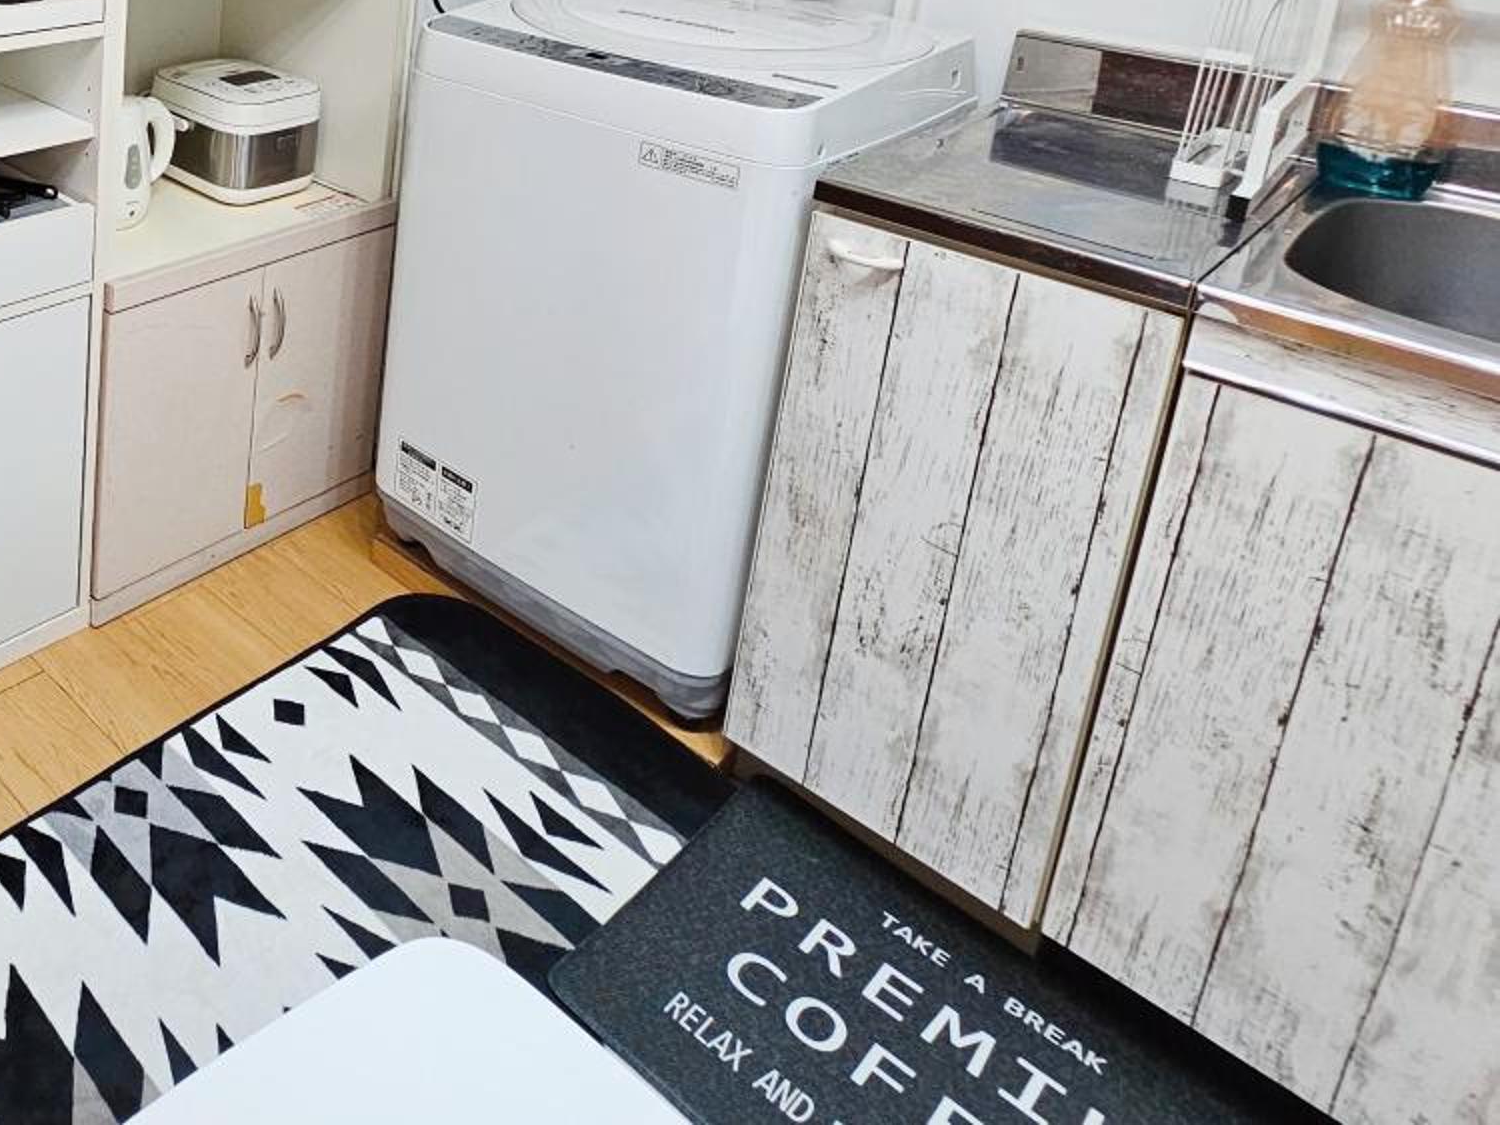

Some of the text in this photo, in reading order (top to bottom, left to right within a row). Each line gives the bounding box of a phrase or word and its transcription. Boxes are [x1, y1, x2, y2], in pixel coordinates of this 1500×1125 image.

[663, 991, 815, 1124] RELAX AND
[739, 876, 1106, 1125] PREMI
[882, 911, 1108, 1074] TAKE A BREAK
